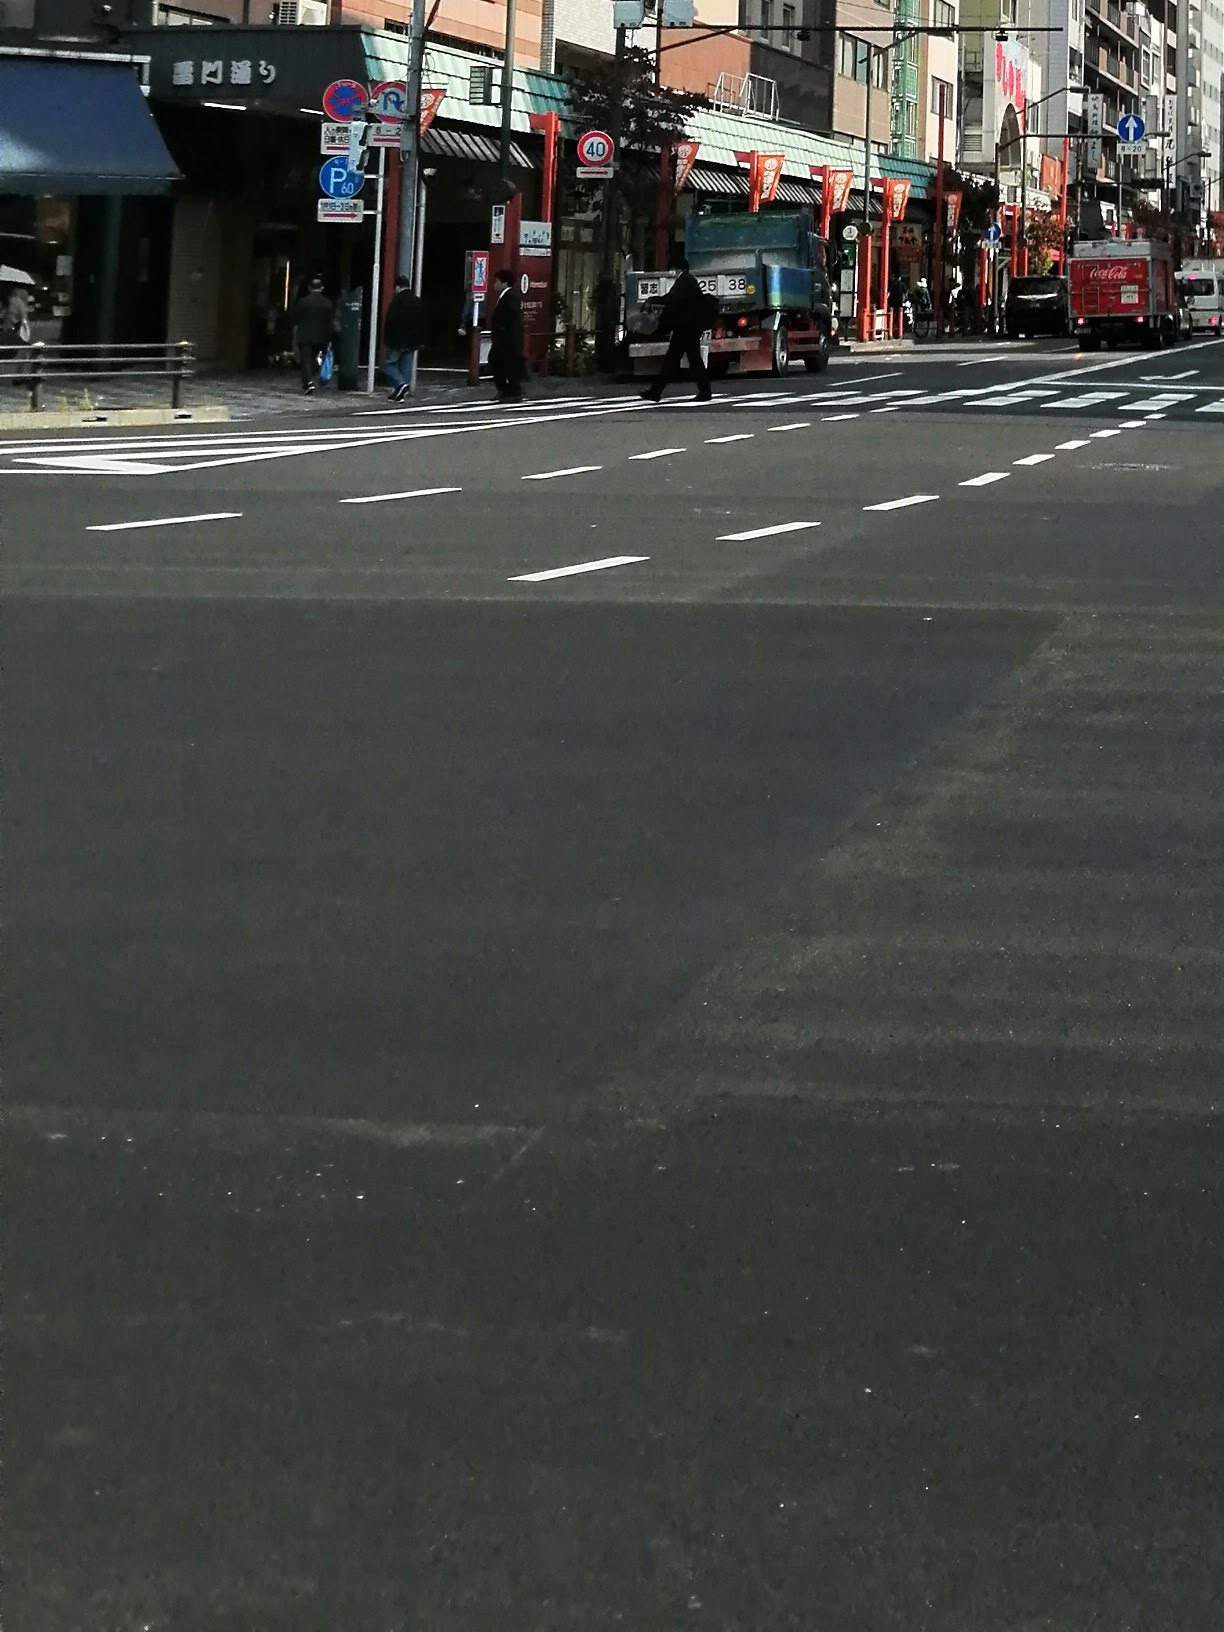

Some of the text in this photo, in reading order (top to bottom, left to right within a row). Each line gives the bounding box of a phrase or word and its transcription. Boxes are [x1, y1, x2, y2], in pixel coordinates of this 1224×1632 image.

[172, 60, 276, 85] 雷門通り
[586, 142, 606, 157] 40
[330, 167, 354, 194] P 60
